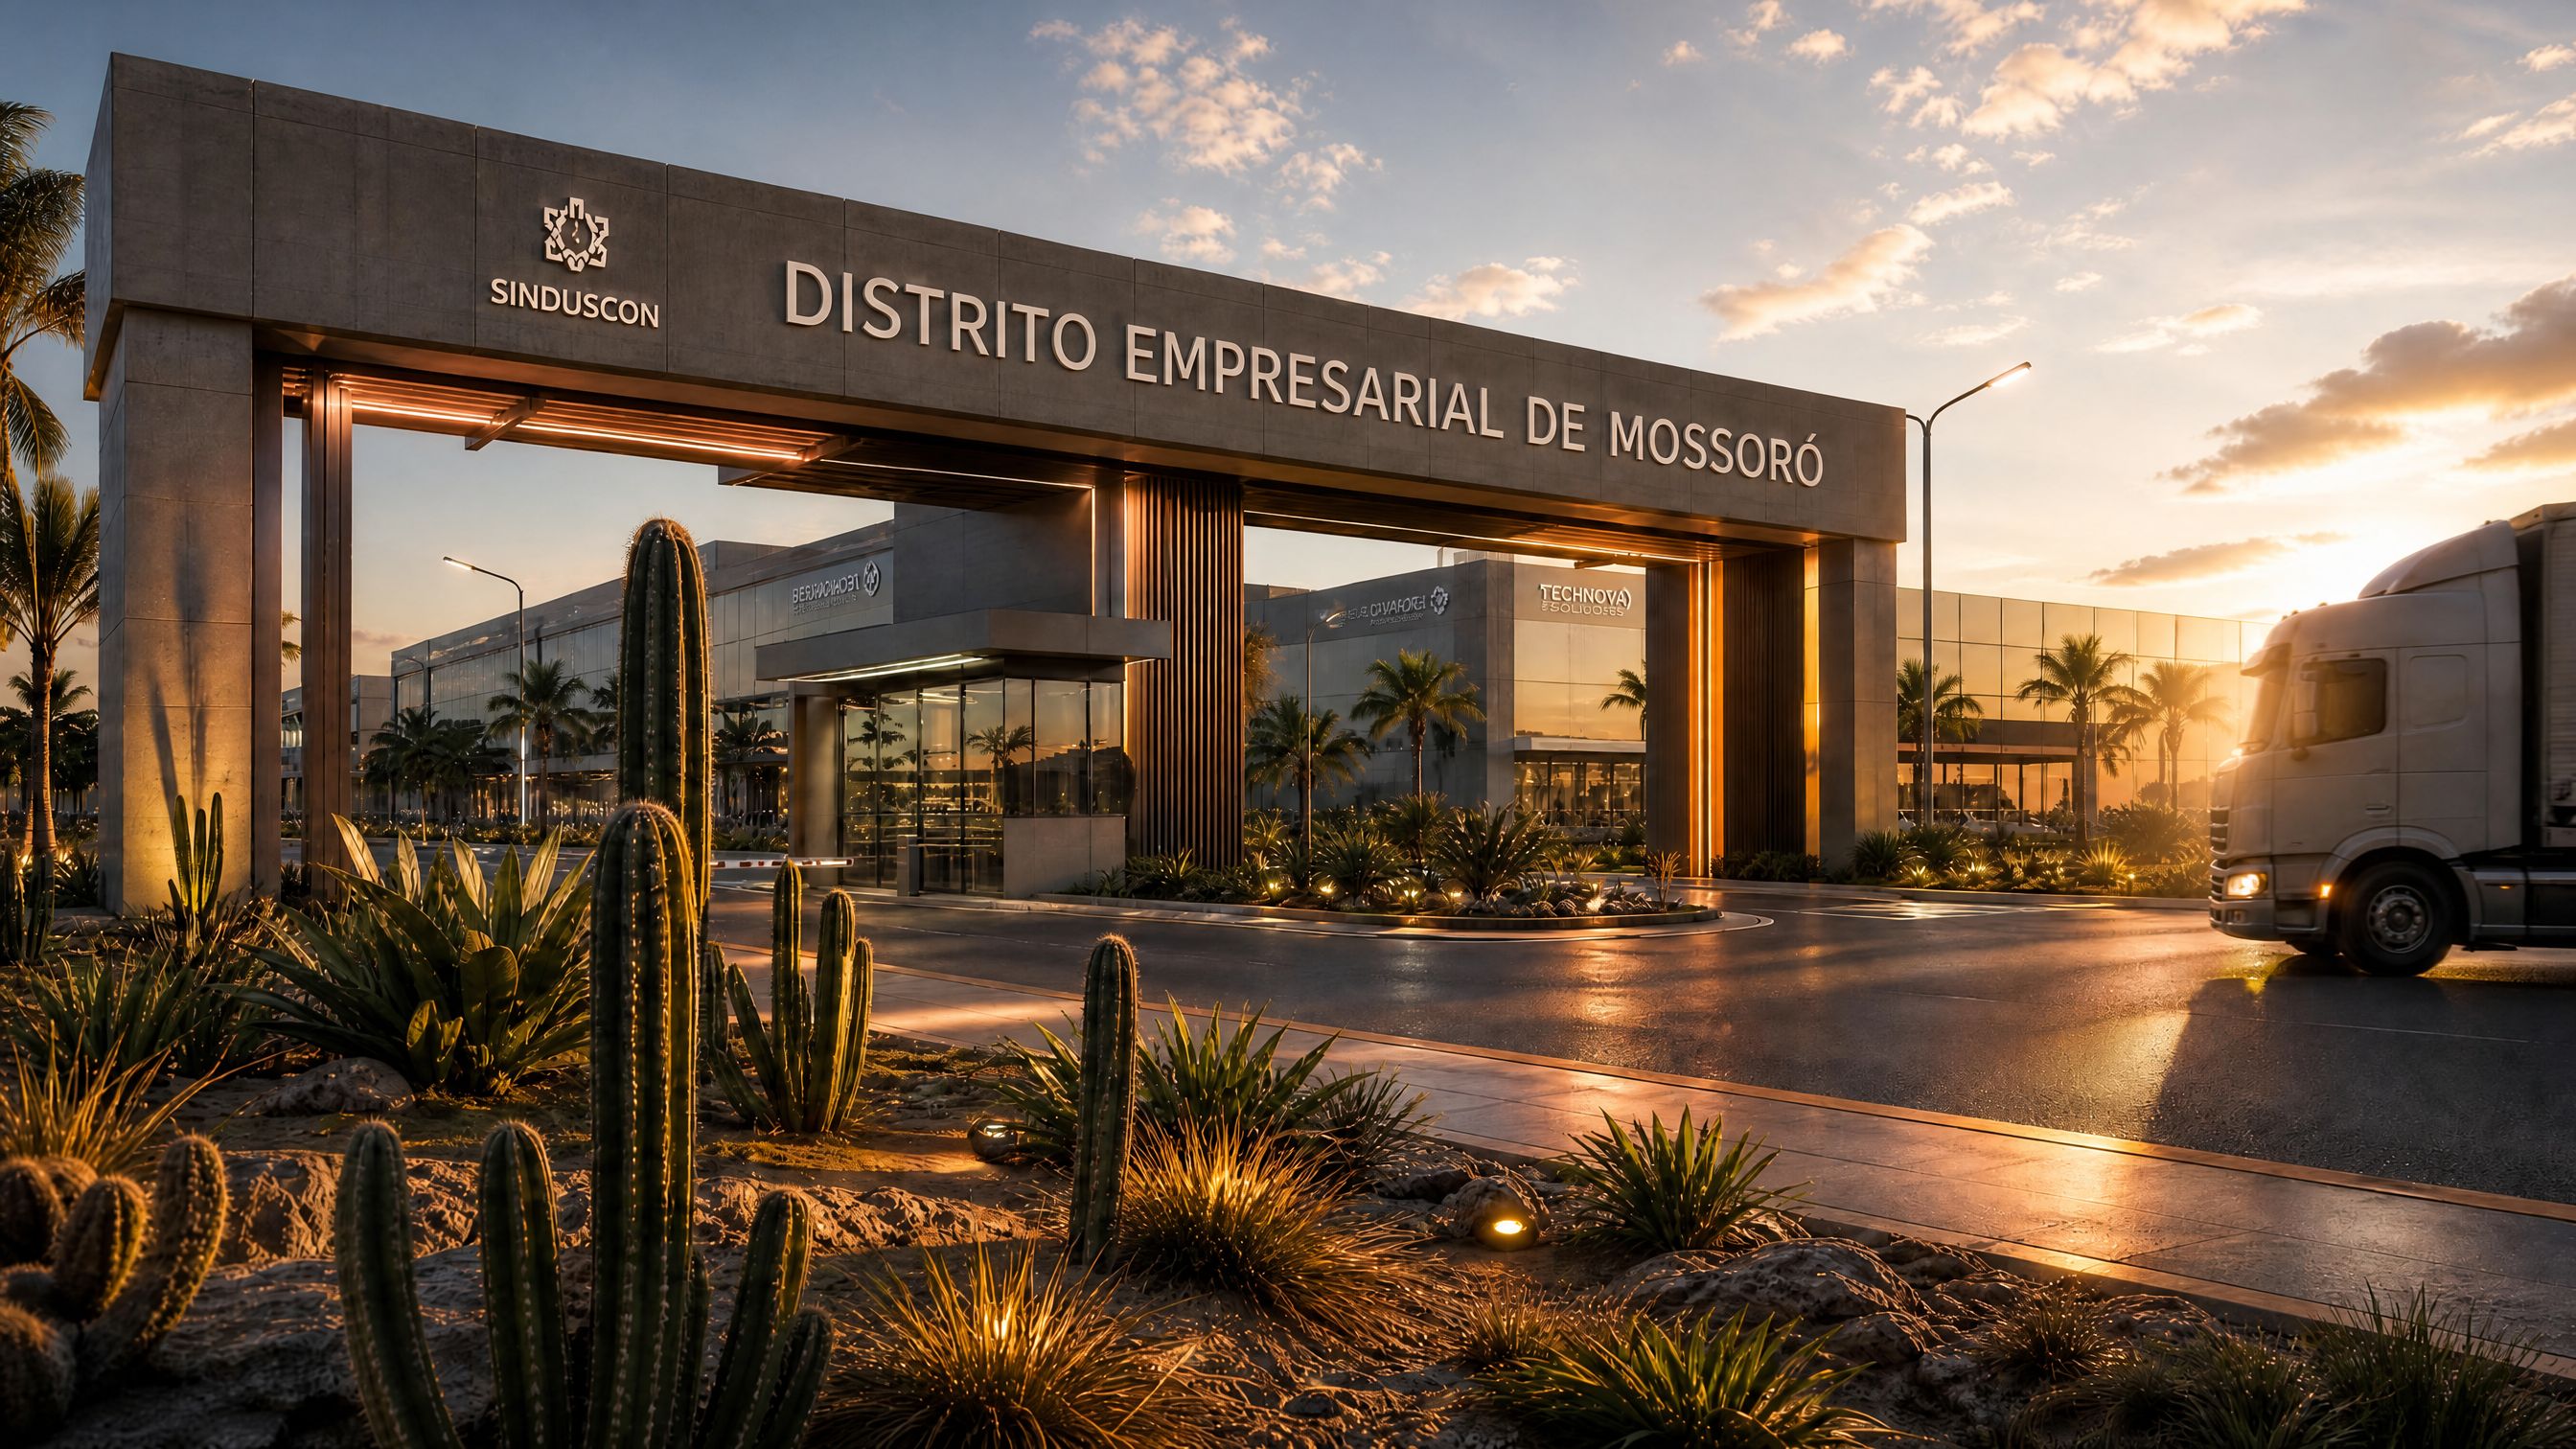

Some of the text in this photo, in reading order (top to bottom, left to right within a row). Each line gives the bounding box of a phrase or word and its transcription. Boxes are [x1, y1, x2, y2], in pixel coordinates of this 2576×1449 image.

[491, 278, 659, 329] SINDUSCON
[785, 260, 1825, 488] DISTRITO EMPRESARIAL DE MOSSORÓ
[1539, 583, 1628, 608] TECHNOVA
